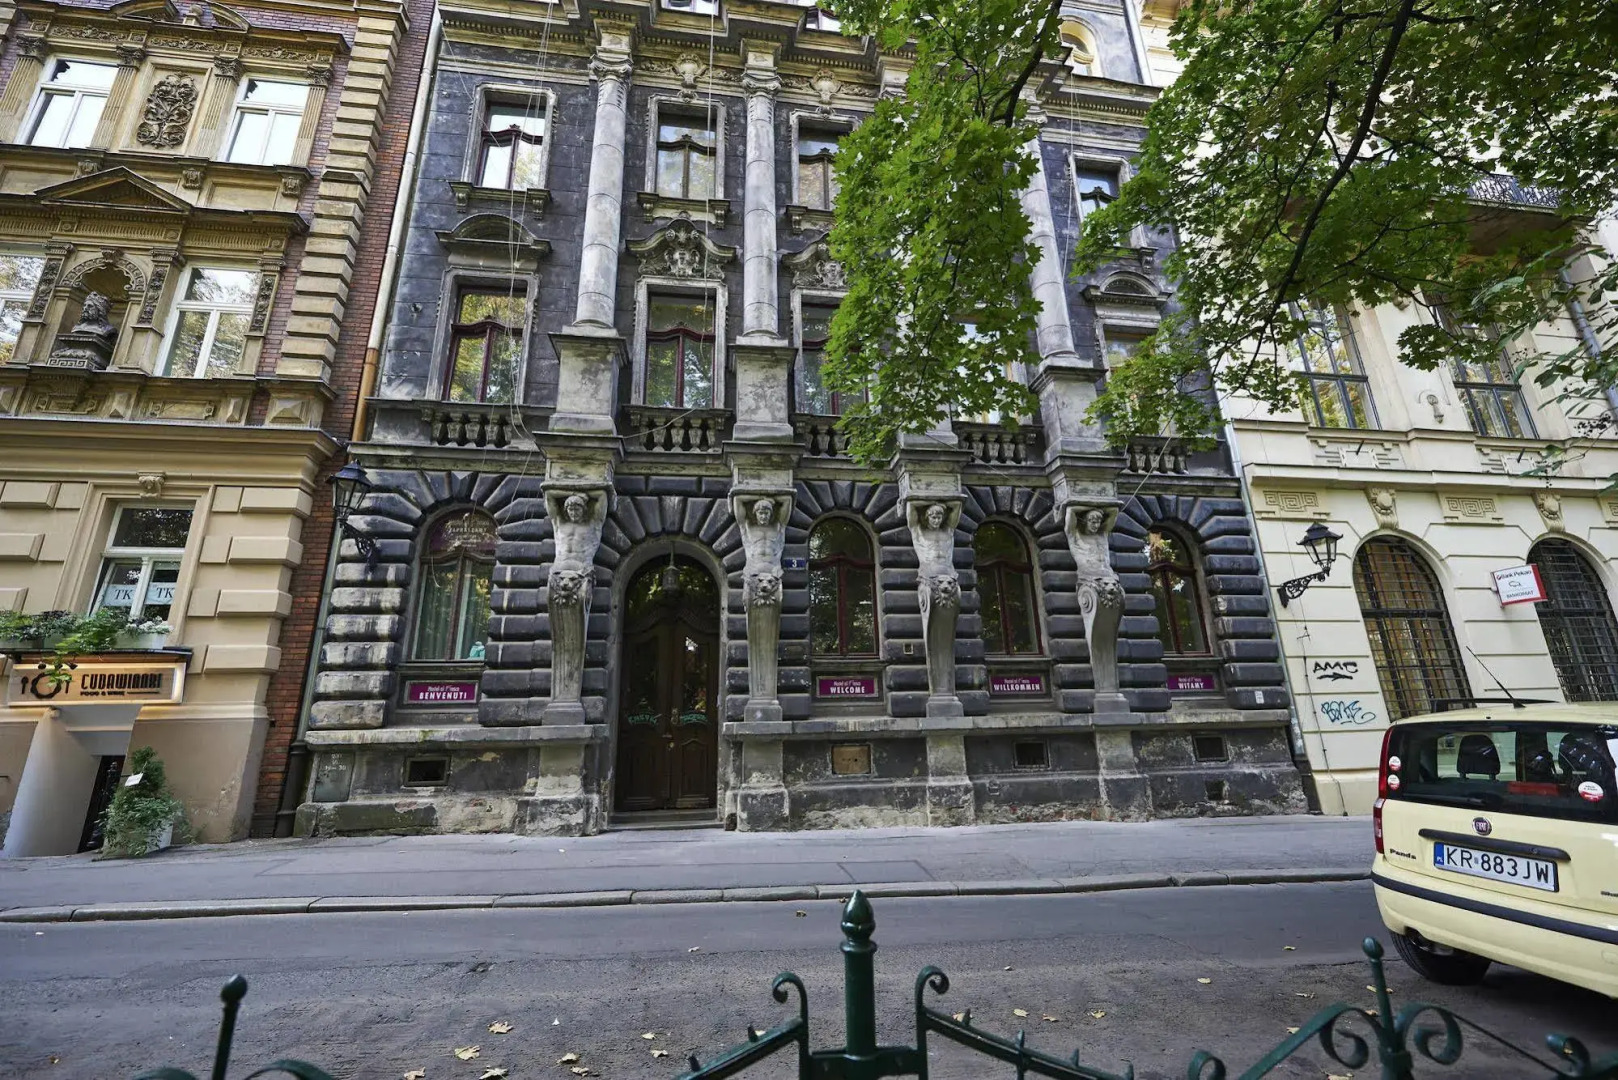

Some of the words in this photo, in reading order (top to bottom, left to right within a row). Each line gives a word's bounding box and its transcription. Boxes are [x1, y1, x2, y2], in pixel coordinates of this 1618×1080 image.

[792, 559, 798, 568] 3
[830, 686, 866, 694] WELCOME
[419, 691, 467, 700] BENVENUTI
[1475, 821, 1487, 831] FIAT
[1389, 848, 1417, 860] Panda
[1446, 847, 1473, 869] KR
